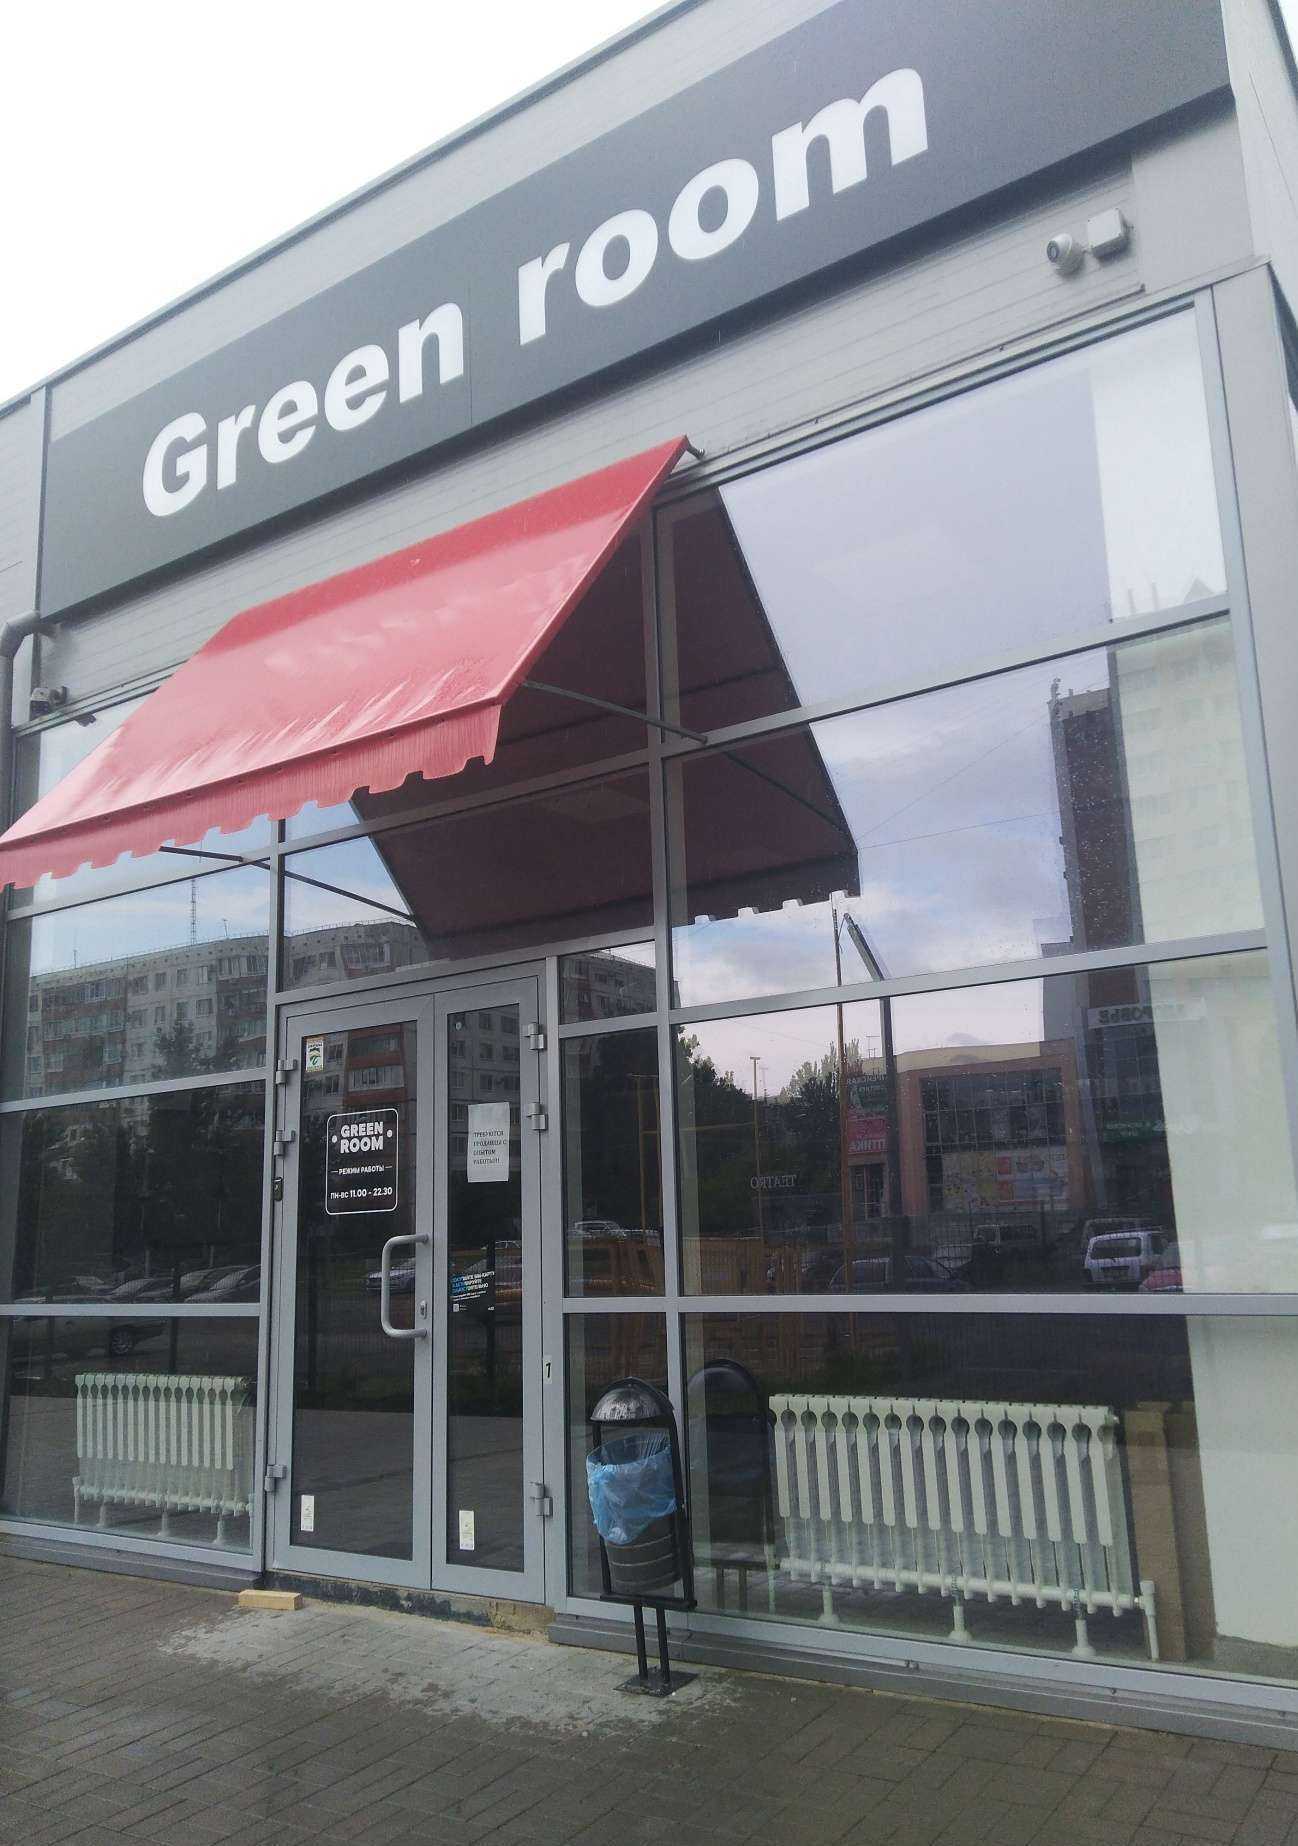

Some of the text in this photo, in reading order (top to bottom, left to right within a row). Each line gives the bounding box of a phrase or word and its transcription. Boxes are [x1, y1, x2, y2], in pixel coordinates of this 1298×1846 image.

[142, 67, 929, 518] Green room
[340, 1121, 384, 1138] GREEN
[340, 1135, 384, 1154] ROOM
[338, 1165, 385, 1175] РЕЖИМ РАБОТЫ
[330, 1191, 349, 1200] ПН-ВС
[350, 1188, 367, 1198] 11.00
[373, 1186, 393, 1196] 22.30
